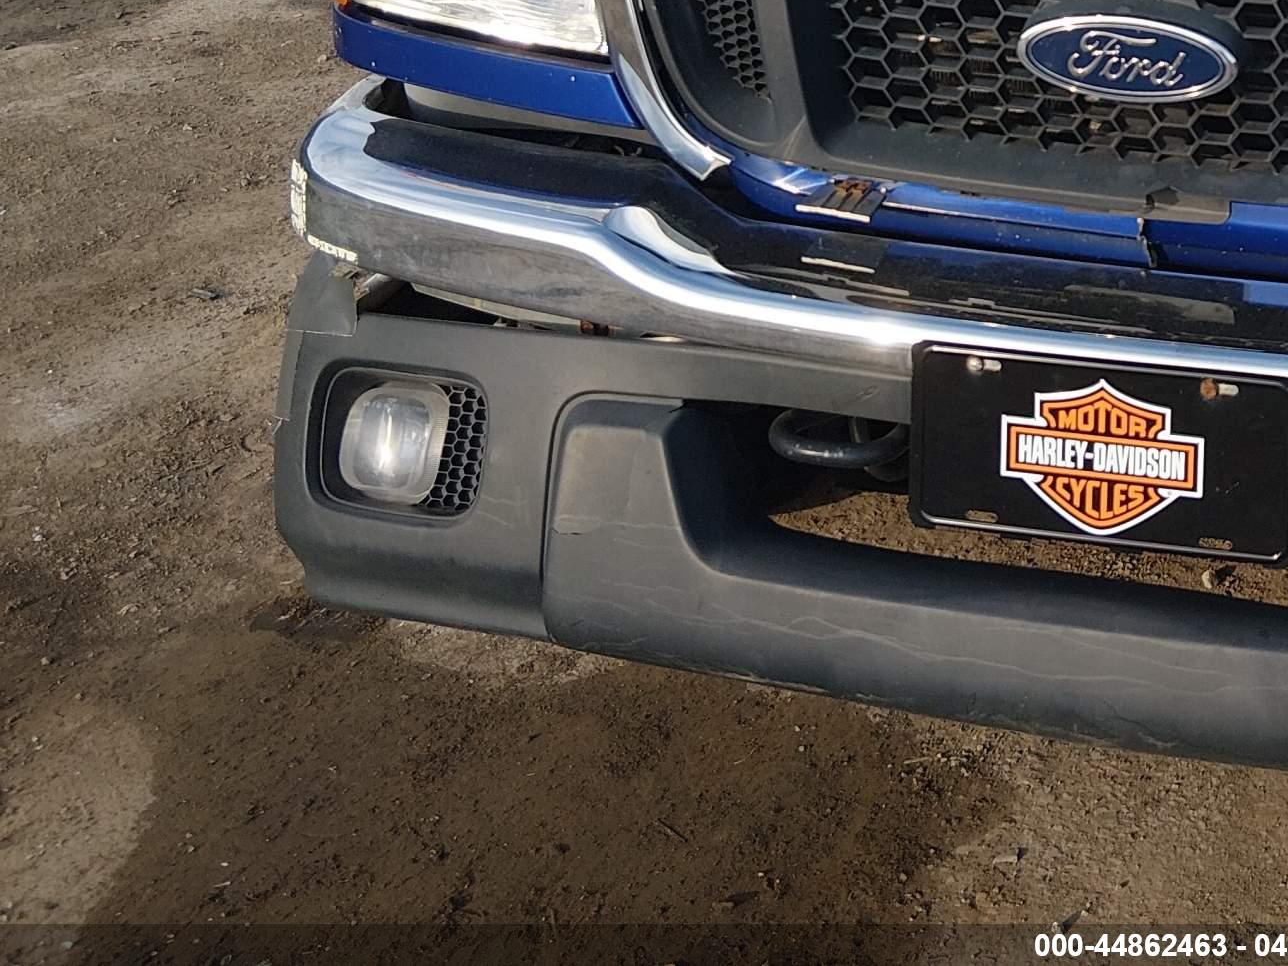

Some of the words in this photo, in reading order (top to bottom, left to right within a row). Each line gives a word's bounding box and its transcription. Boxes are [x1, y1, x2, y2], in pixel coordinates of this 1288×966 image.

[1067, 30, 1184, 86] Ford
[1058, 400, 1148, 438] MOTOR
[1017, 433, 1186, 481] HARLEY-DAVIDSON
[1055, 478, 1145, 520] CYCLES
